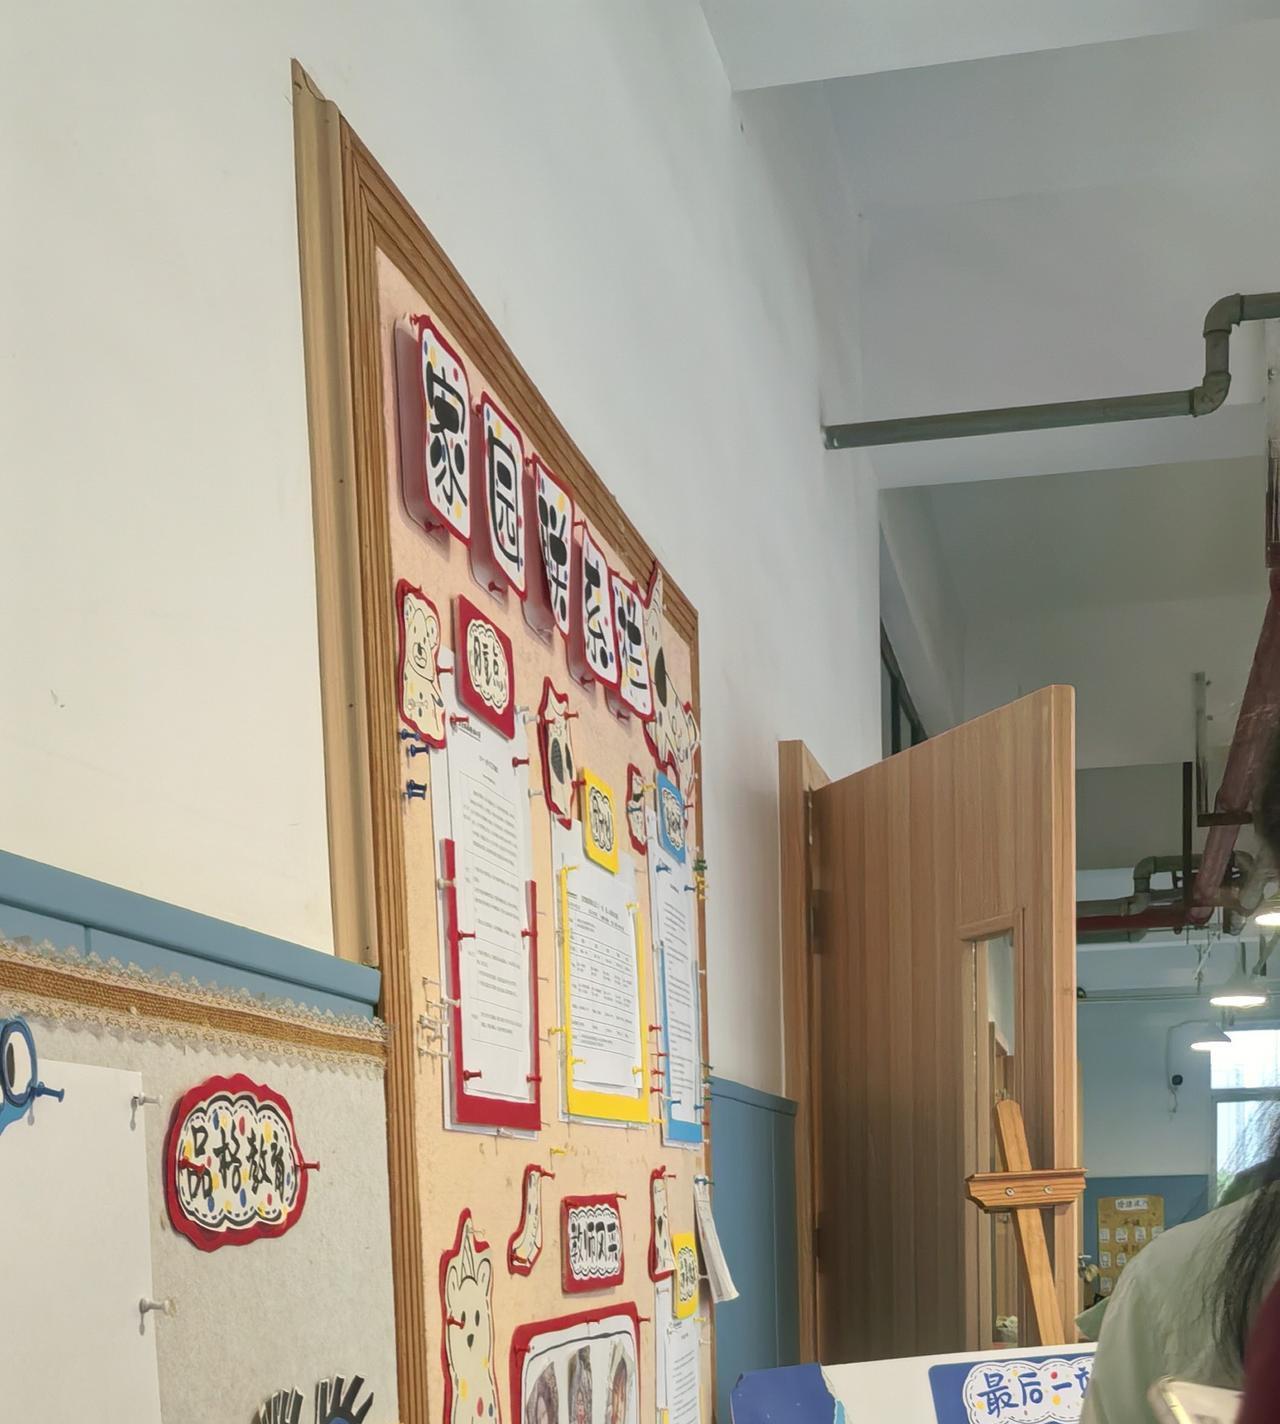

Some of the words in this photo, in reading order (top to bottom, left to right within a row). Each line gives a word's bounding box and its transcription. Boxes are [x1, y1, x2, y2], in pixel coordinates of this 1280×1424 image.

[427, 365, 648, 690] 家园联系栏
[187, 1123, 286, 1203] 品格教育
[571, 1221, 618, 1264] 教师风采
